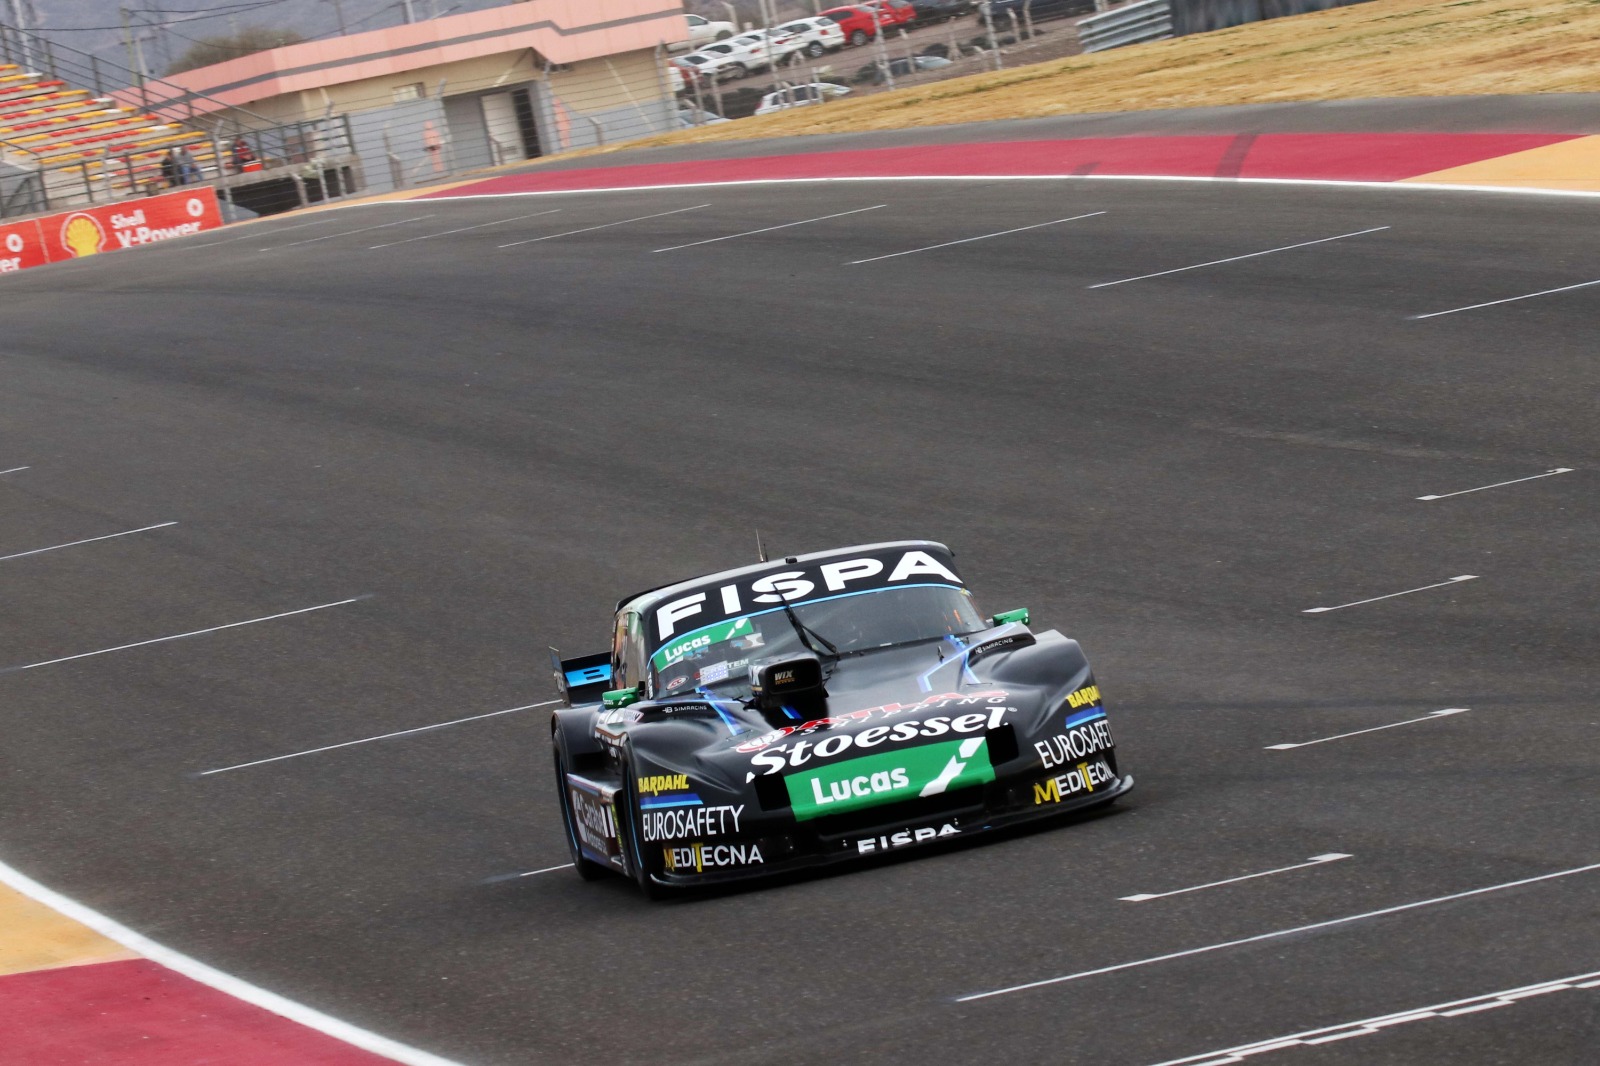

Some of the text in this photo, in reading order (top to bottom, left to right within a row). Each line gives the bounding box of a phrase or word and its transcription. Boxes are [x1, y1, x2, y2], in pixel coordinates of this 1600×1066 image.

[110, 209, 147, 230] Shell
[115, 221, 202, 249] V-Power
[656, 551, 963, 641] FISPA
[664, 634, 711, 662] Lucas
[726, 659, 749, 669] TEM
[745, 706, 1009, 784] Stoessel
[1034, 719, 1115, 770] EUROSAFET
[638, 774, 689, 797] BARDAHL
[811, 767, 910, 805] Lucas
[1033, 761, 1114, 805] MEDITECN
[642, 804, 745, 842] EUROSAFETY
[857, 823, 962, 854] FISPA
[663, 842, 764, 873] MEDITECNA
